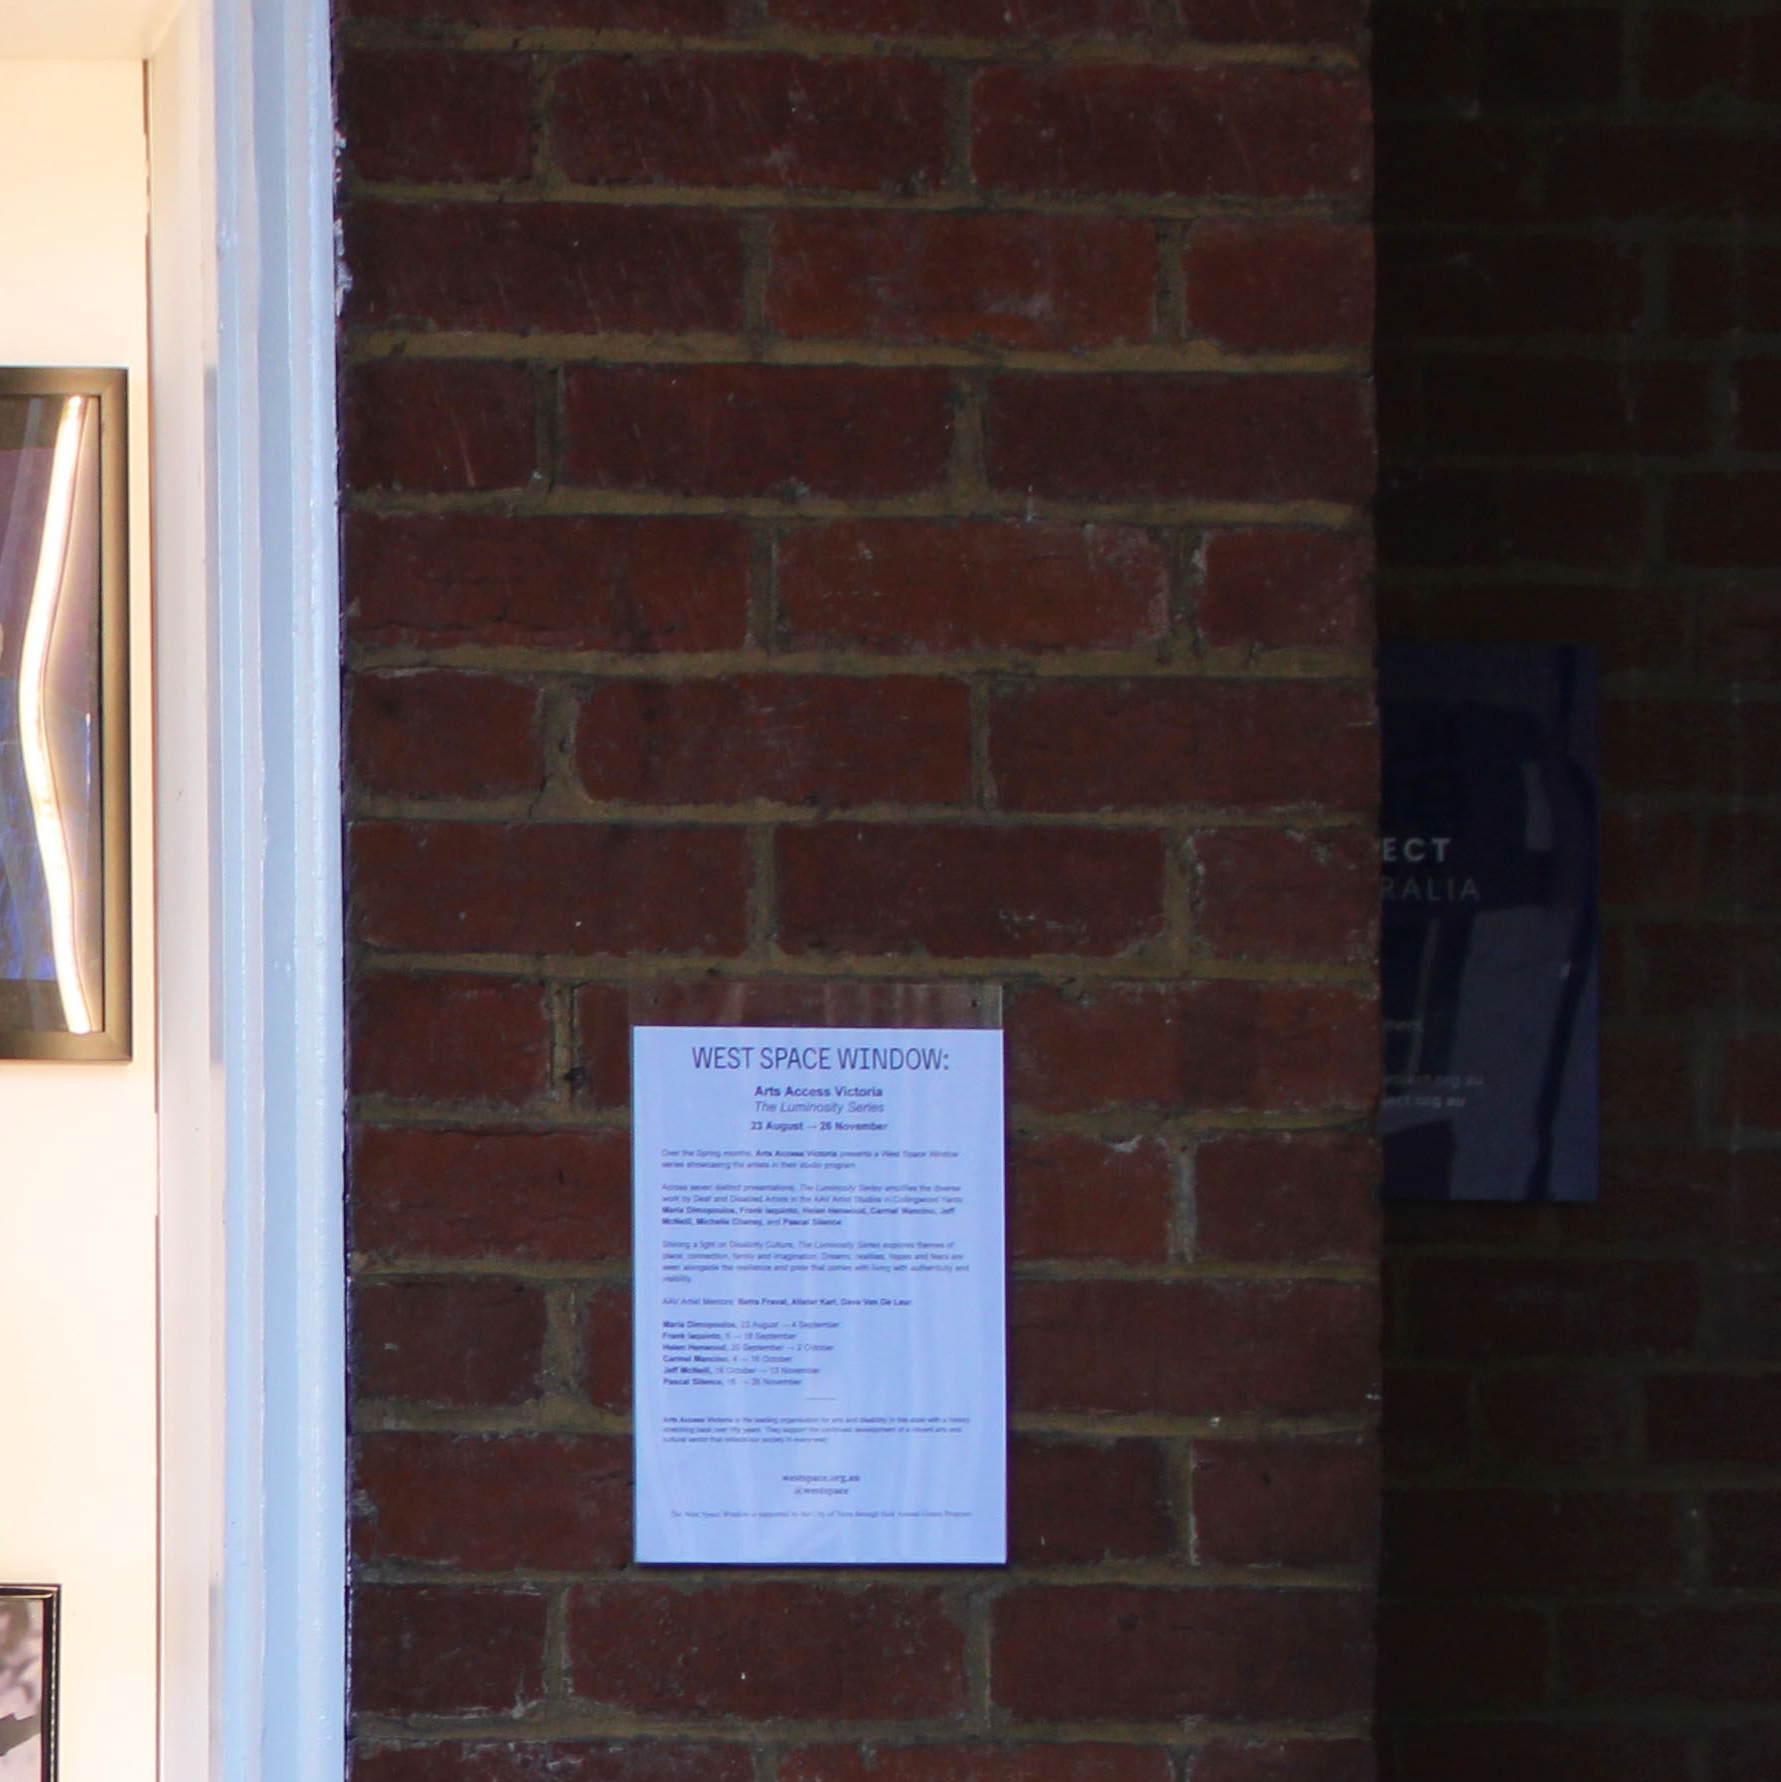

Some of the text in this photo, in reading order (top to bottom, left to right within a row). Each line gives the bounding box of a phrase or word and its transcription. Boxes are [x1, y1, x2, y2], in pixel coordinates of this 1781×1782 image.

[1382, 836, 1450, 863] ECT
[1380, 876, 1480, 902] RALIA
[692, 1047, 950, 1070] WEST SPACE WINDOW:
[754, 1086, 883, 1097] Arts Access Victoria
[754, 1101, 885, 1115] The Luminosity Series
[750, 1121, 888, 1132] 23 August 26 November
